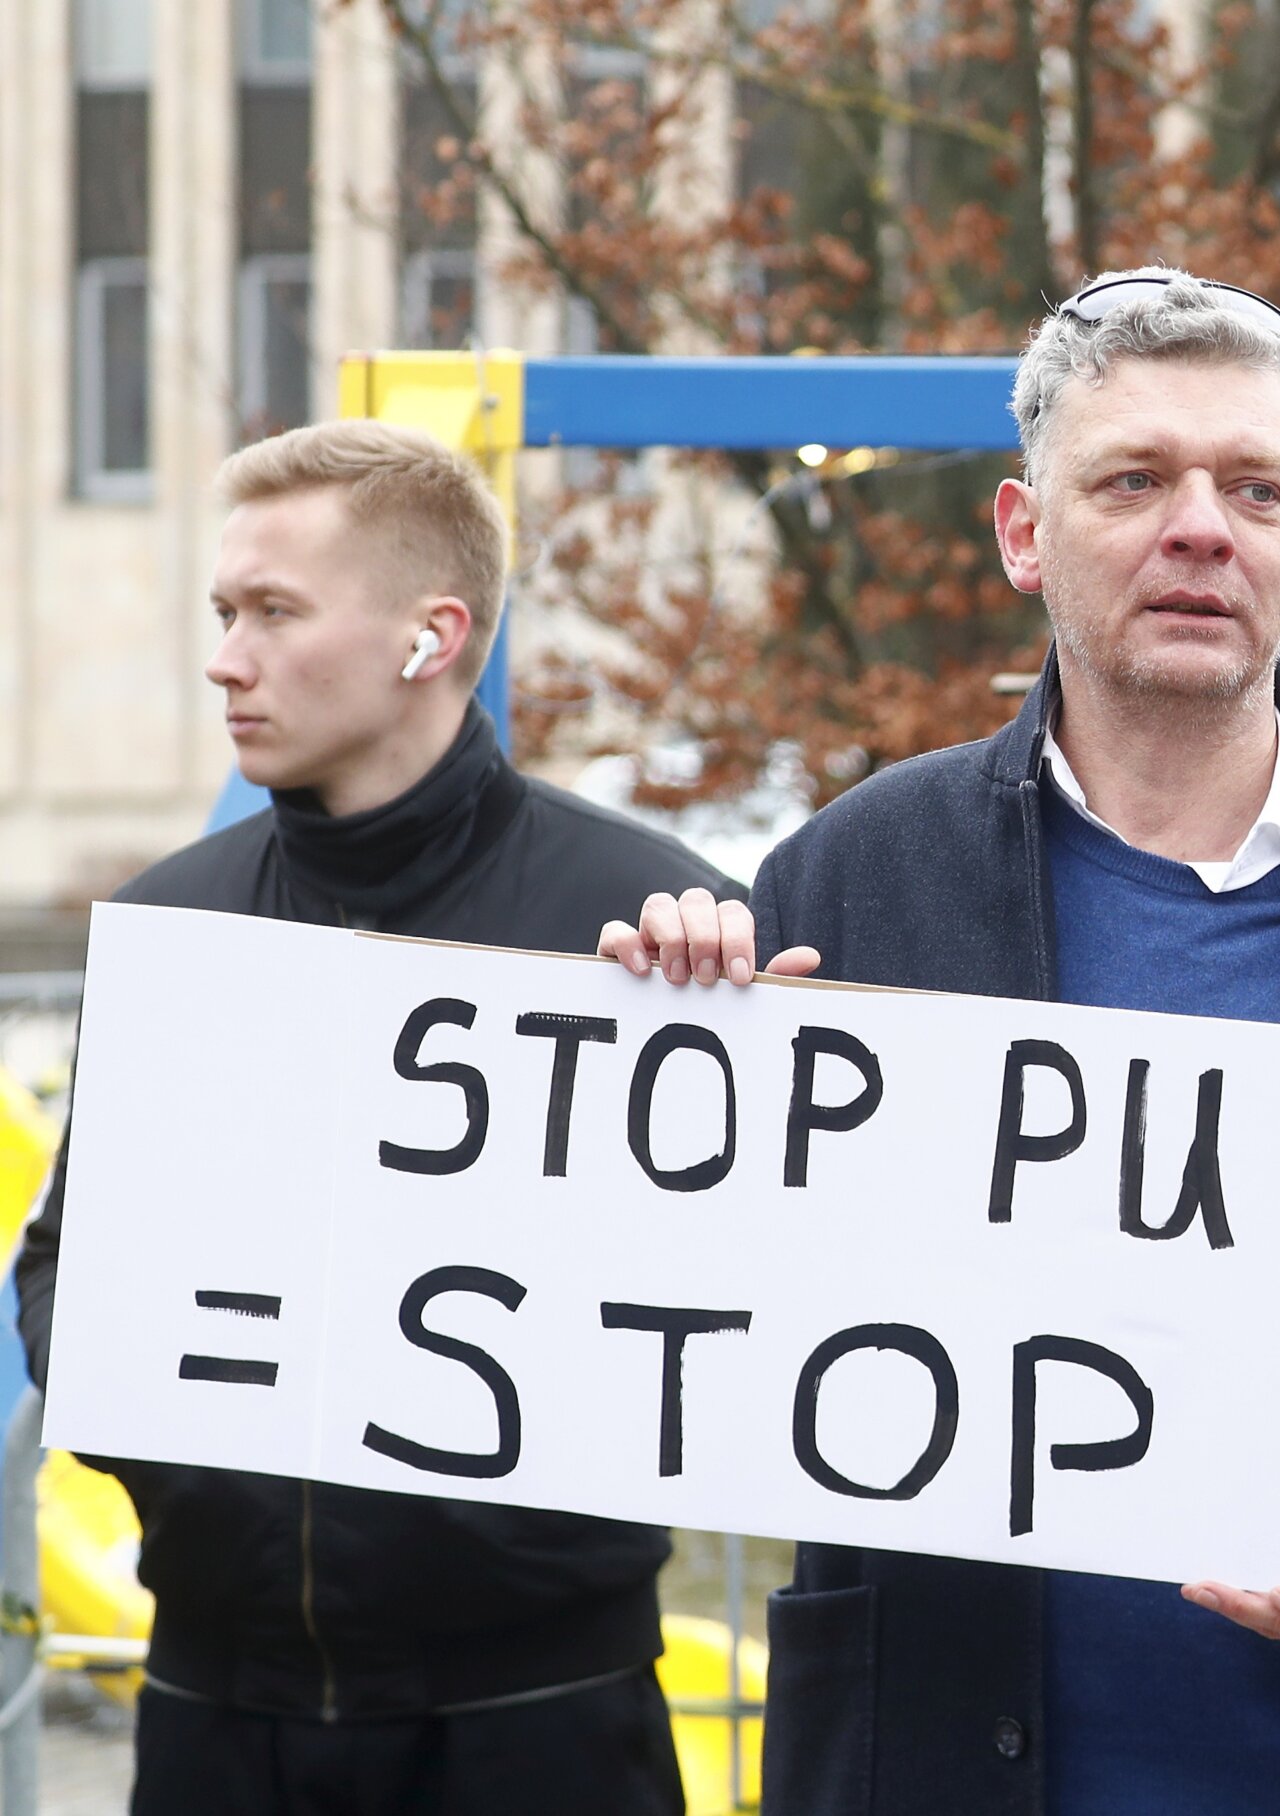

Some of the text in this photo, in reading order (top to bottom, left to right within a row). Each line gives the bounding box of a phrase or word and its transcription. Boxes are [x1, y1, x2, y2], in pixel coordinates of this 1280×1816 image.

[378, 997, 883, 1192] STOP
[178, 1290, 282, 1387] =
[362, 1265, 1154, 1538] STOP
